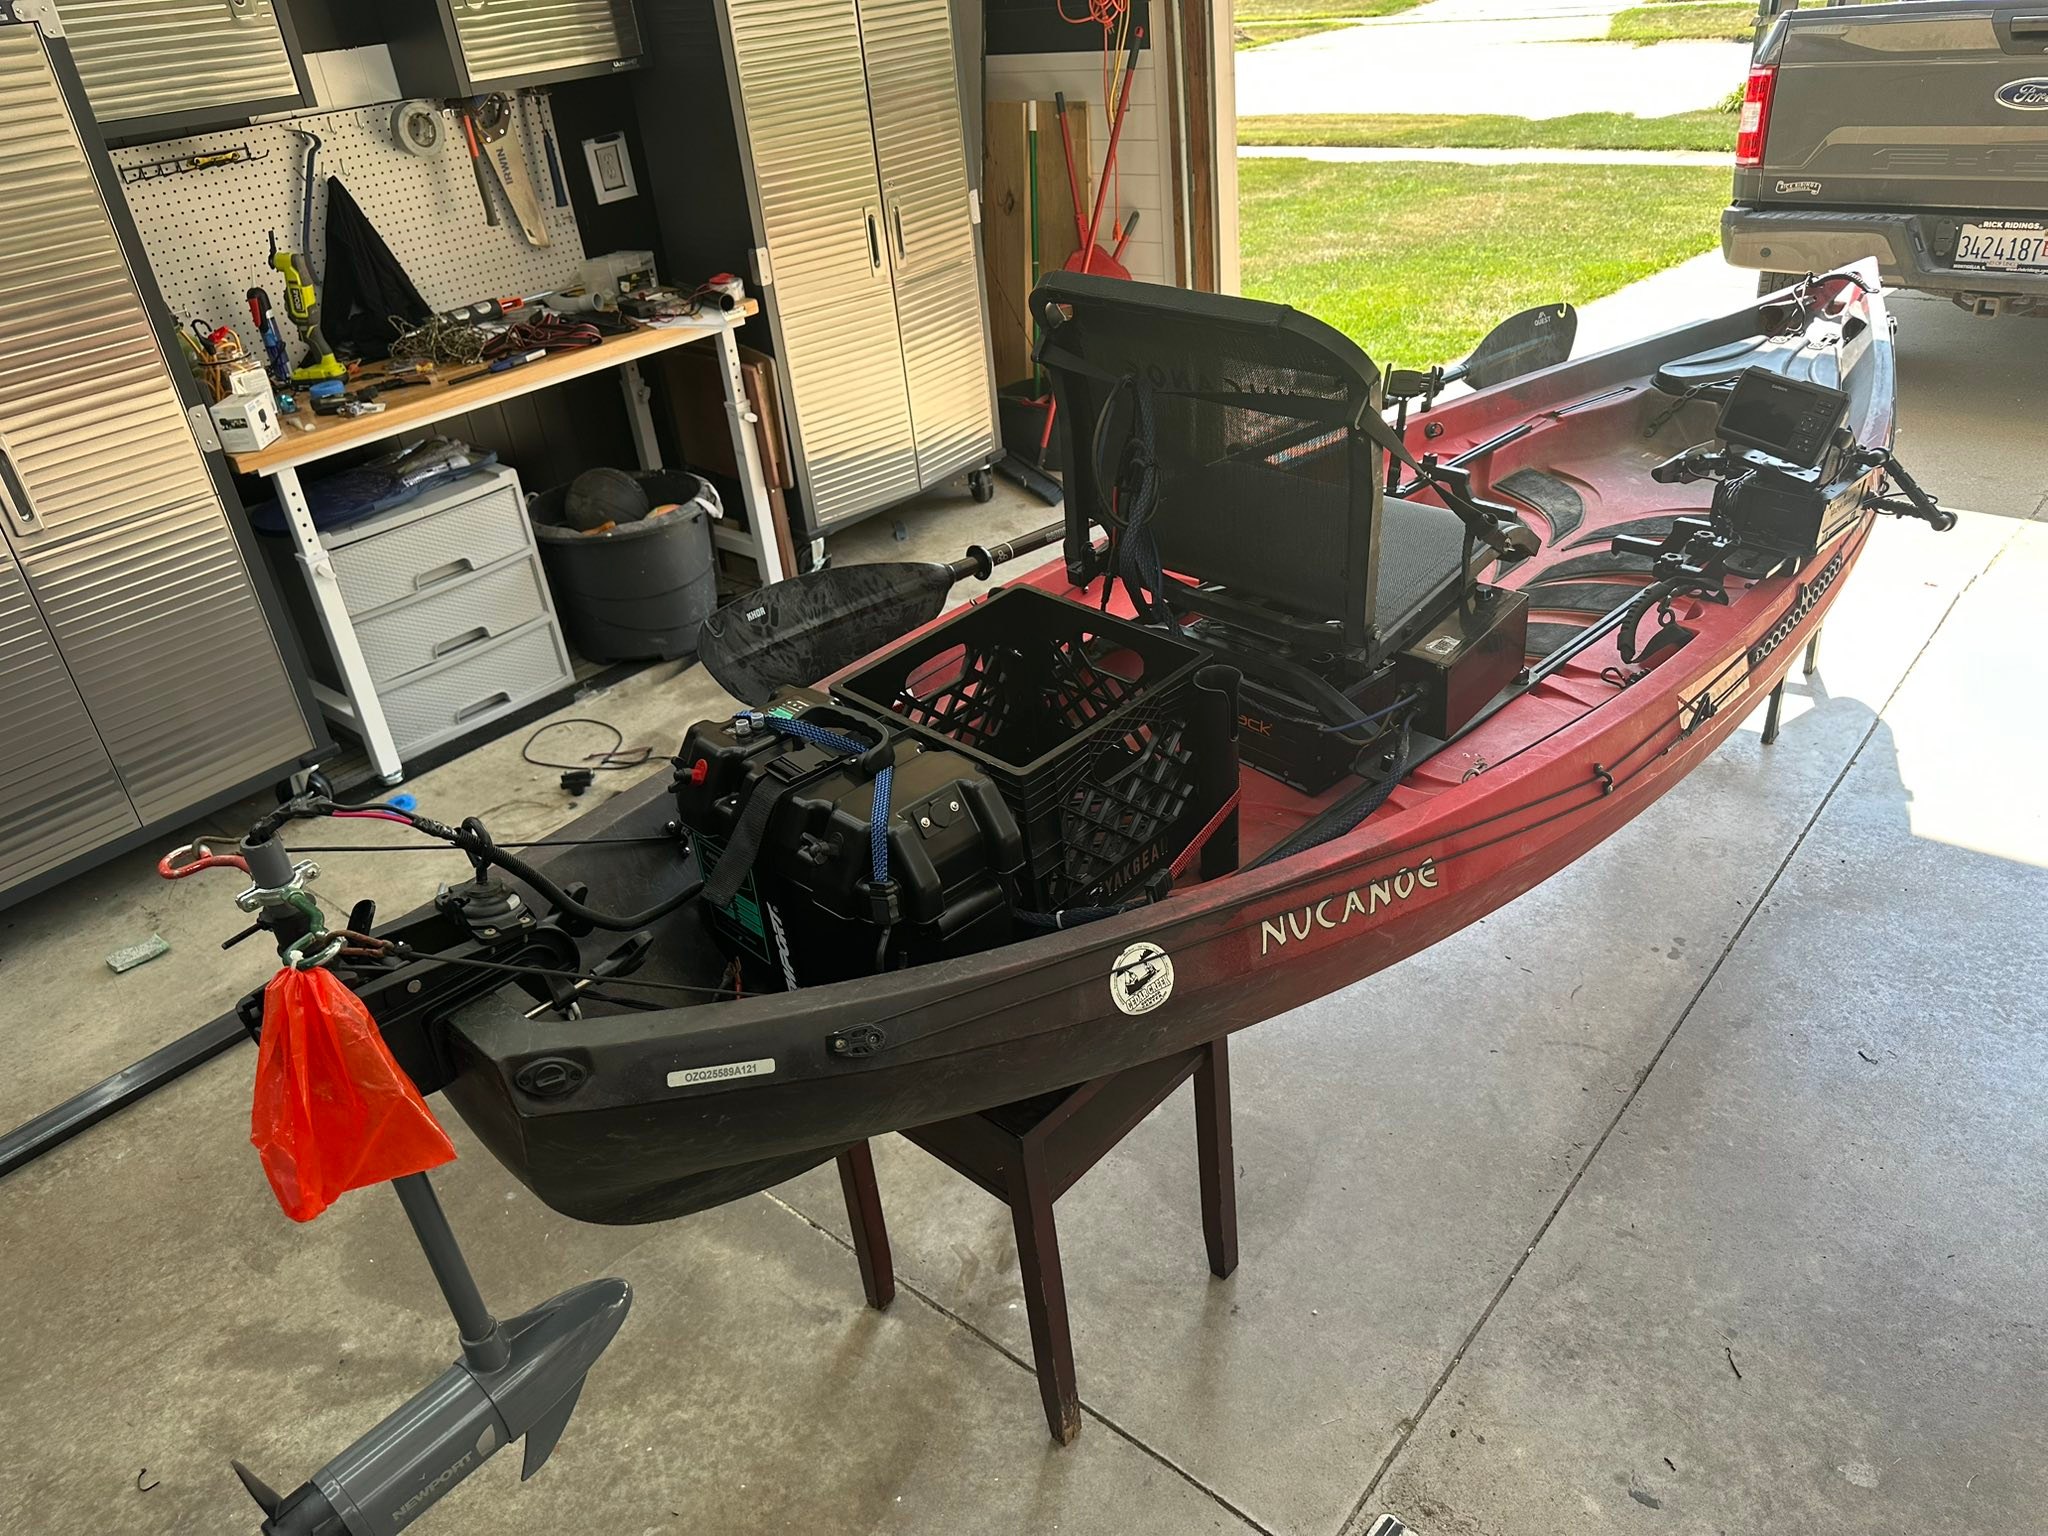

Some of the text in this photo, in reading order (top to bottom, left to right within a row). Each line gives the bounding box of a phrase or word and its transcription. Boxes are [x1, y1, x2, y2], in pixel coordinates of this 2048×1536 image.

[496, 148, 513, 185] IRWIN
[2004, 221, 2039, 229] RIDINGS
[1958, 235, 2044, 262] 3424187
[1534, 315, 1551, 327] QUEST
[746, 606, 766, 622] KHOR
[1261, 857, 1438, 955] NUCANOE
[1126, 989, 1148, 1011] CEDAR
[1147, 975, 1171, 995] CREEK
[392, 1450, 473, 1521] NEWPORT
